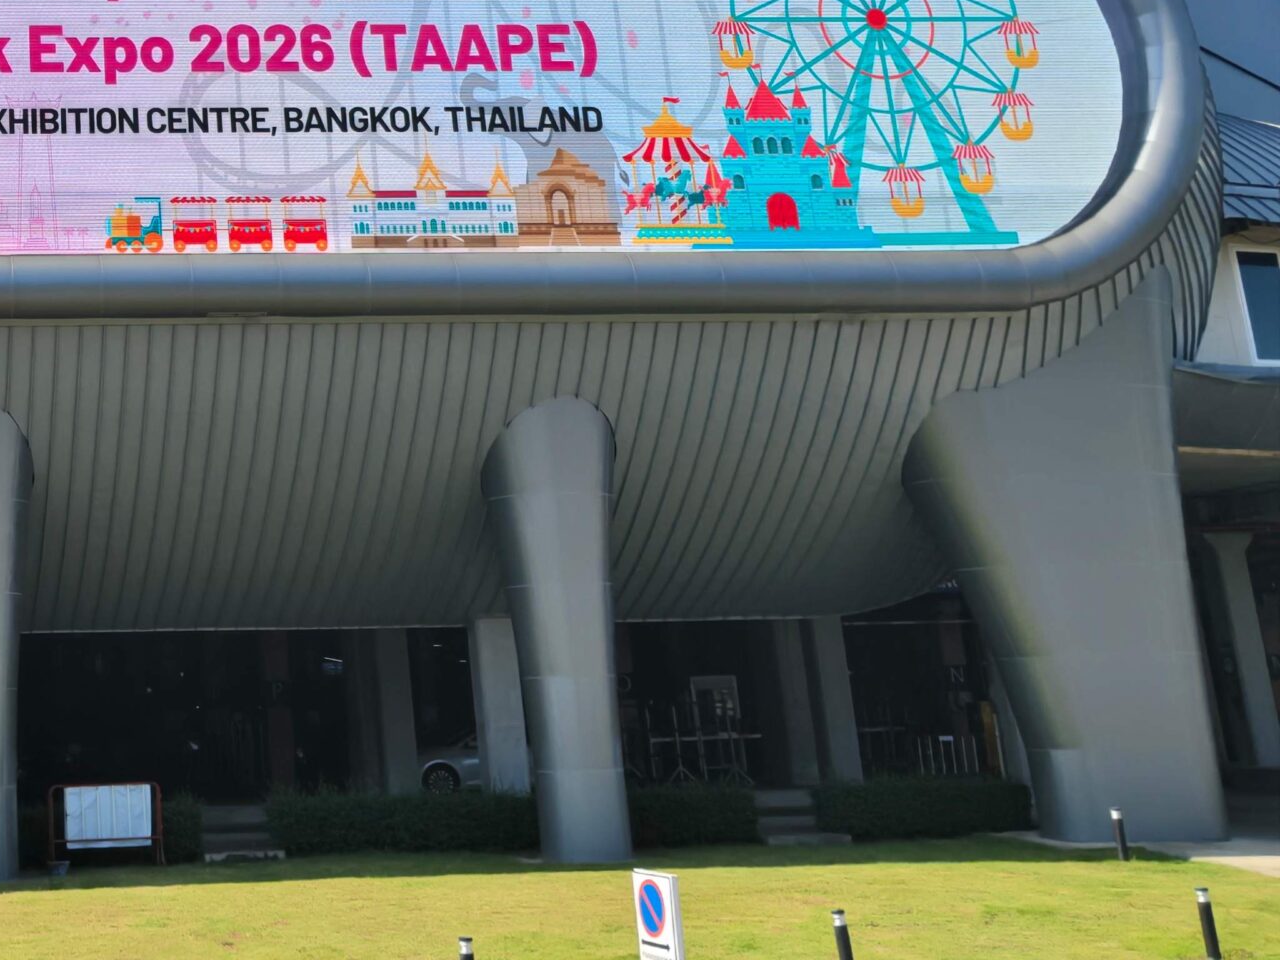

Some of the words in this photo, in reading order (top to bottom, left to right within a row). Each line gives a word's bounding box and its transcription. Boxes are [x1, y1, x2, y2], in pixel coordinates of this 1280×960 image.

[28, 24, 175, 85] Expo
[188, 23, 335, 73] 2026
[349, 20, 598, 78] (TAAPE)
[146, 107, 278, 138] CENTRE,
[288, 106, 440, 136] BANGKOK,
[443, 106, 604, 133] THAILAND
